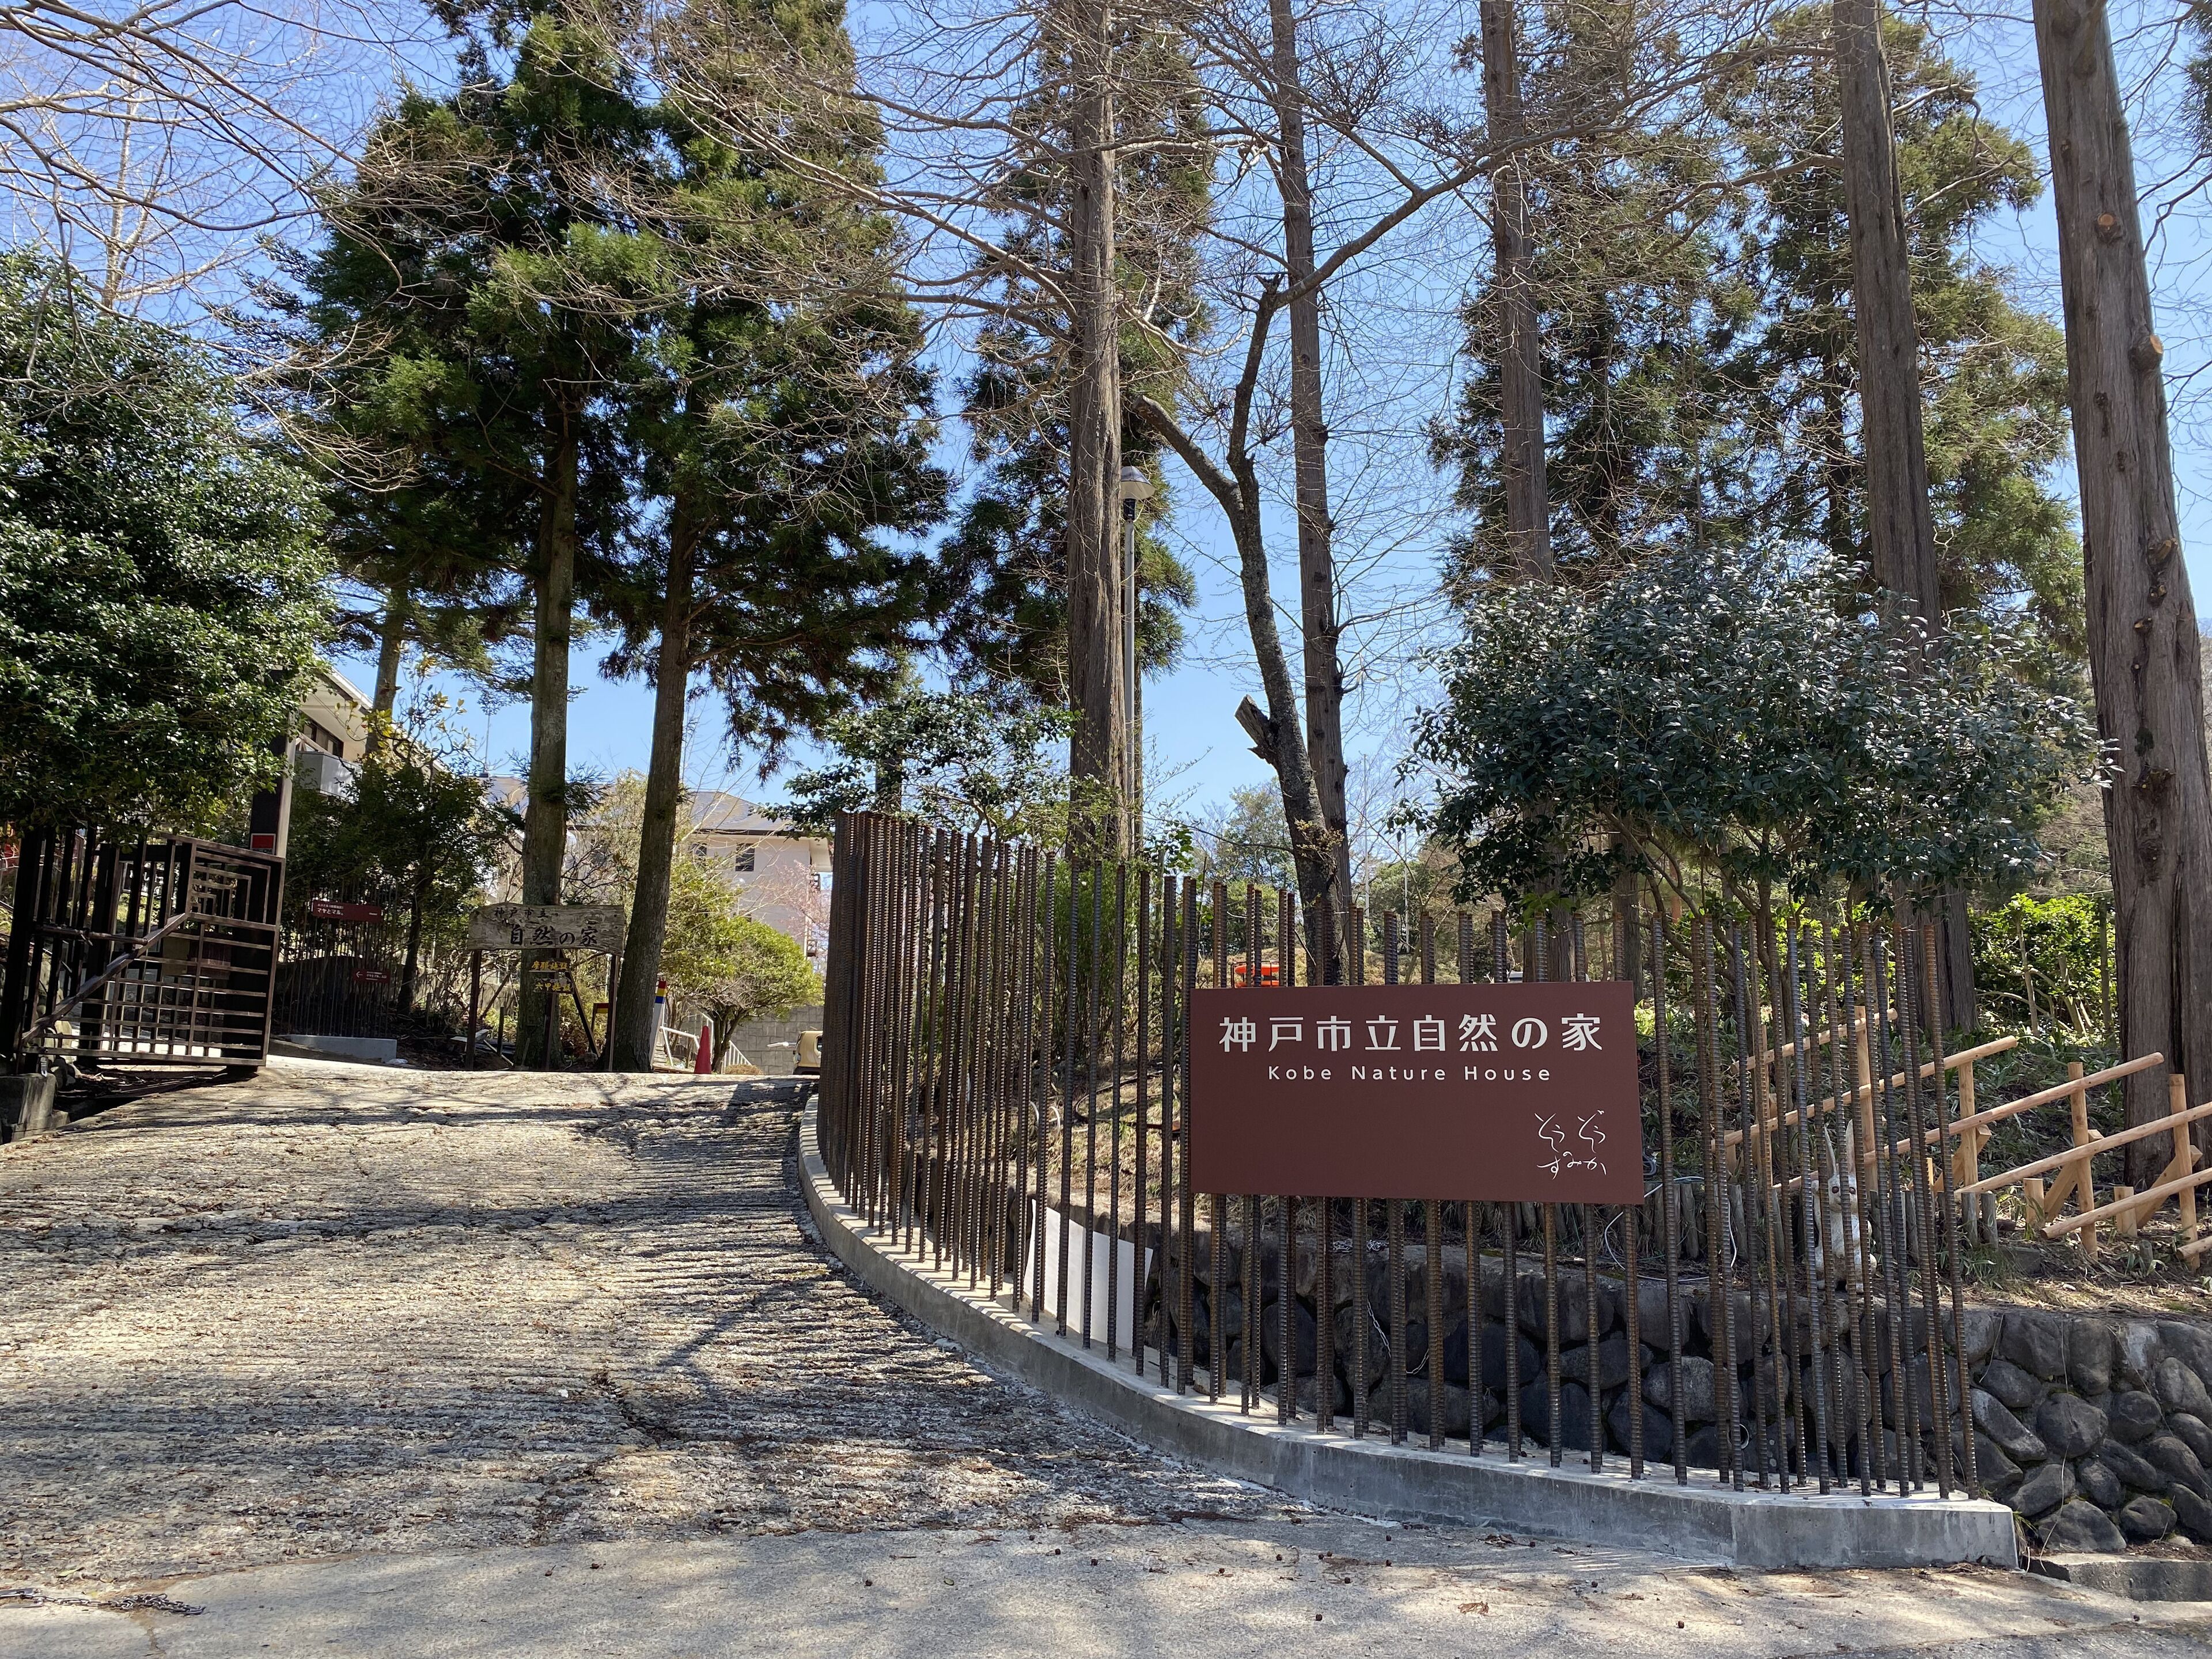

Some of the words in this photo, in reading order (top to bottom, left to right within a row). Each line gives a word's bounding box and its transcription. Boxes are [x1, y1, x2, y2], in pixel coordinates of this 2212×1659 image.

[494, 907, 549, 919] 神戸市立
[510, 925, 599, 947] 自然の家
[1219, 1013, 1603, 1052] 神戸市立自然の家
[1268, 1065, 1331, 1080] Kobe
[1351, 1066, 1445, 1081] Nature
[1464, 1066, 1550, 1081] House
[1536, 1151, 1607, 1180] すみか
